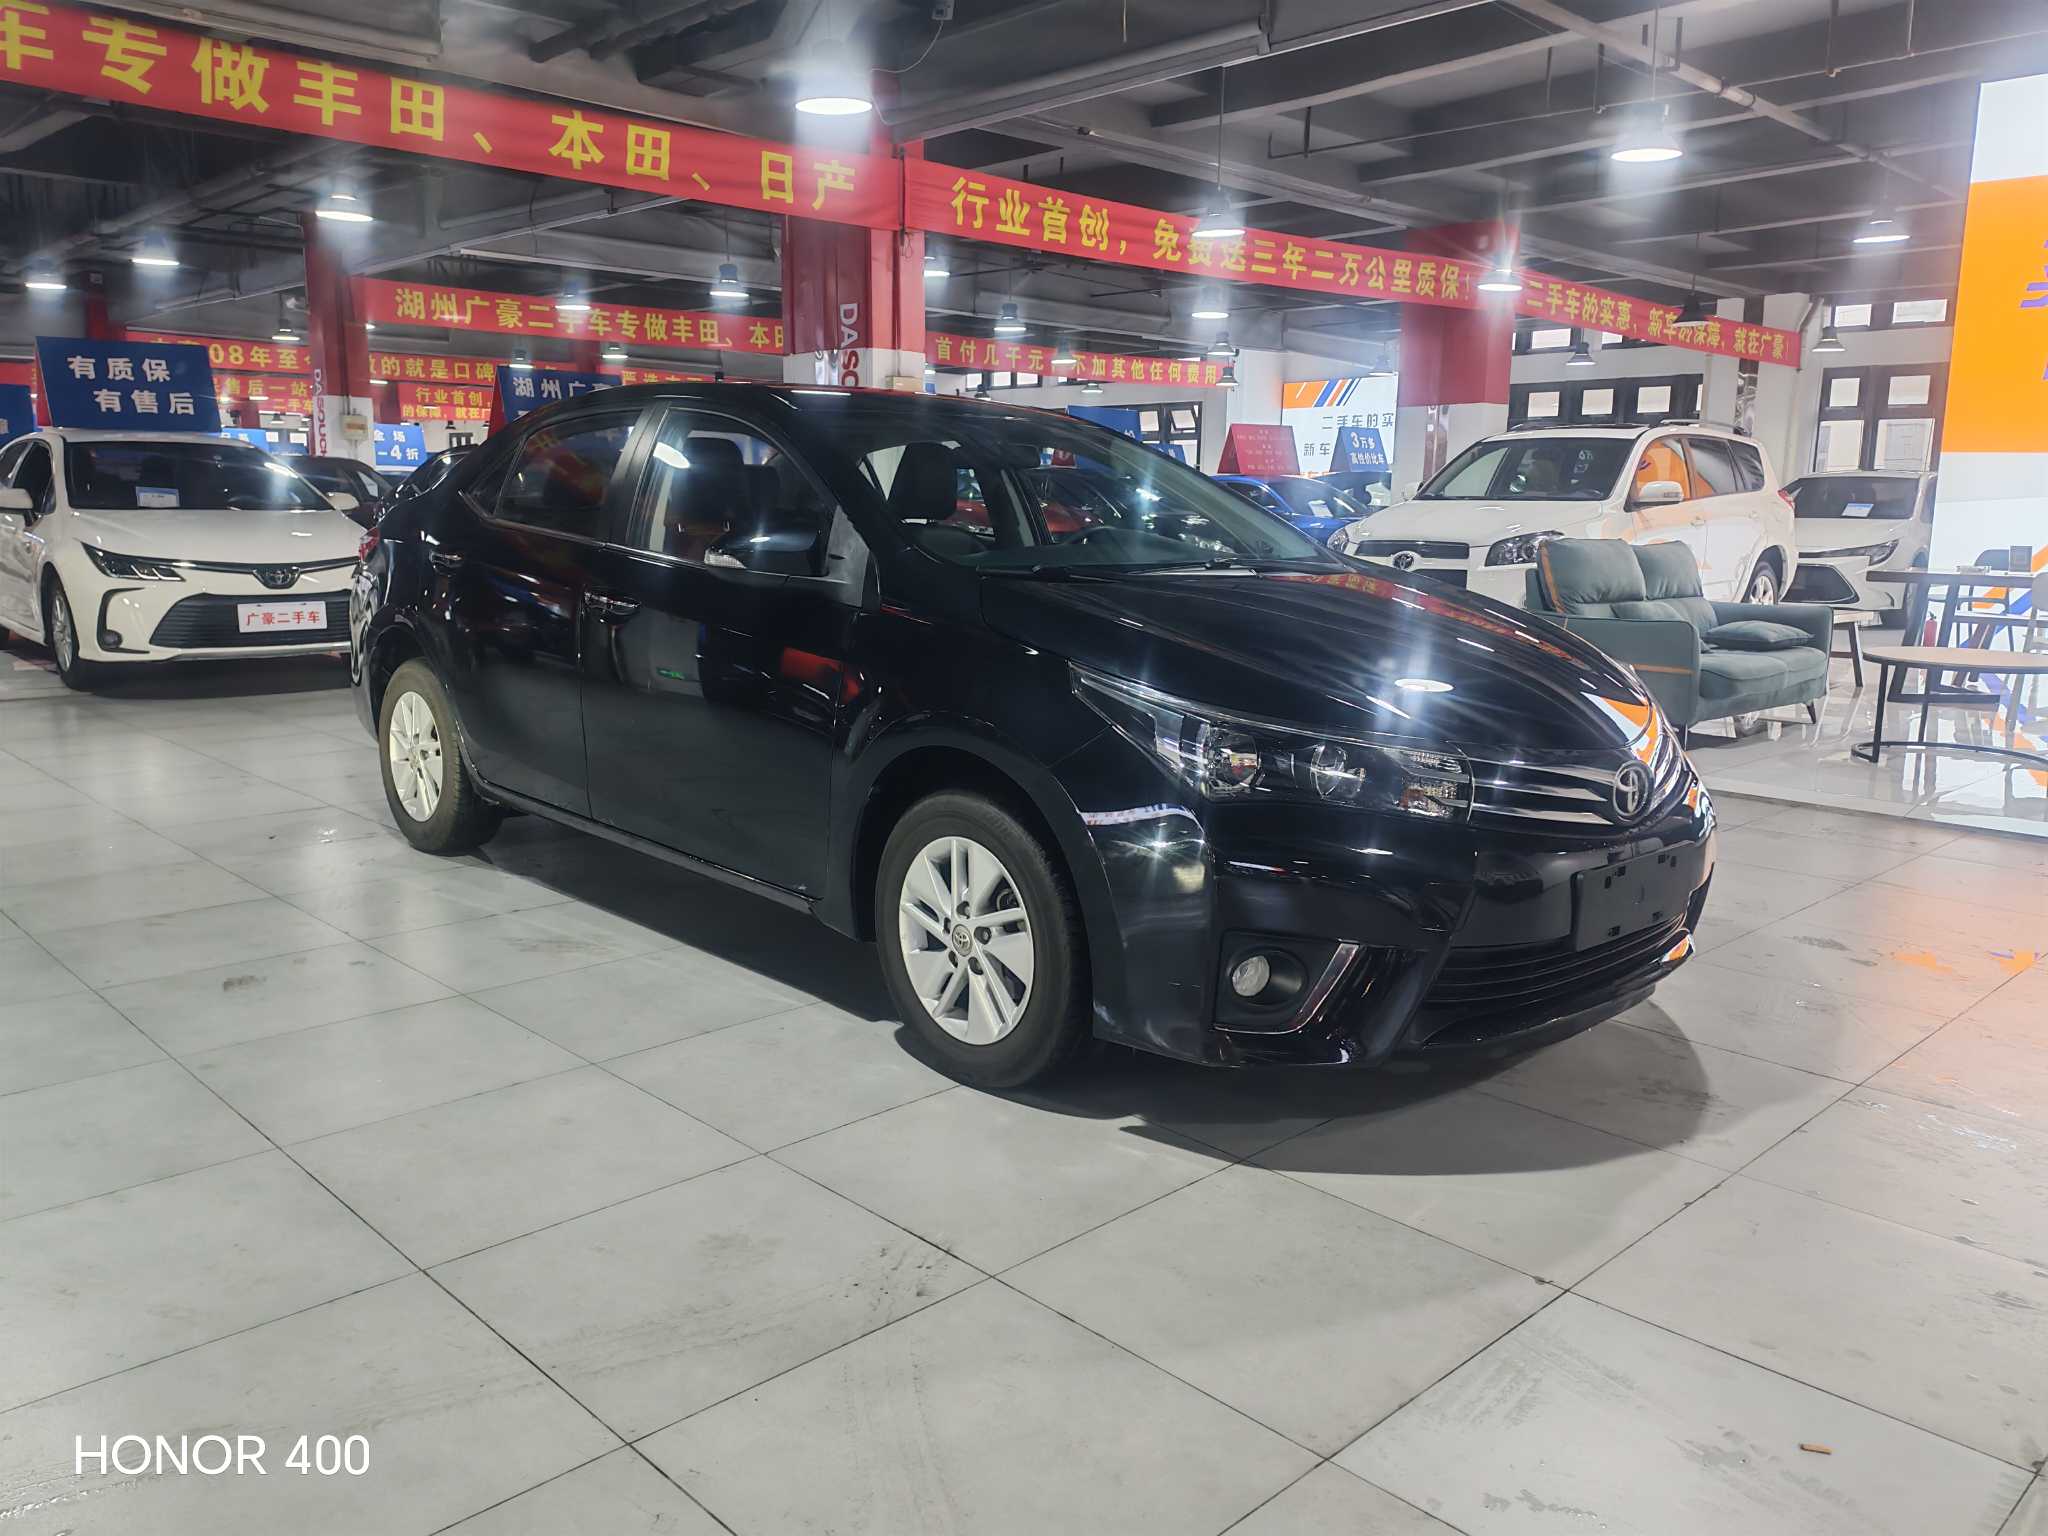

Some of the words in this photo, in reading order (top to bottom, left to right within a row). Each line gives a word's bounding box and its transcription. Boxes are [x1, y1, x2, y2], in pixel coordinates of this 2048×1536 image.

[66, 355, 171, 383] 有质保
[209, 343, 311, 369] 08年至
[513, 376, 611, 400] 湖州广
[93, 388, 195, 416] 有售后
[246, 610, 321, 626] 广豪二手车
